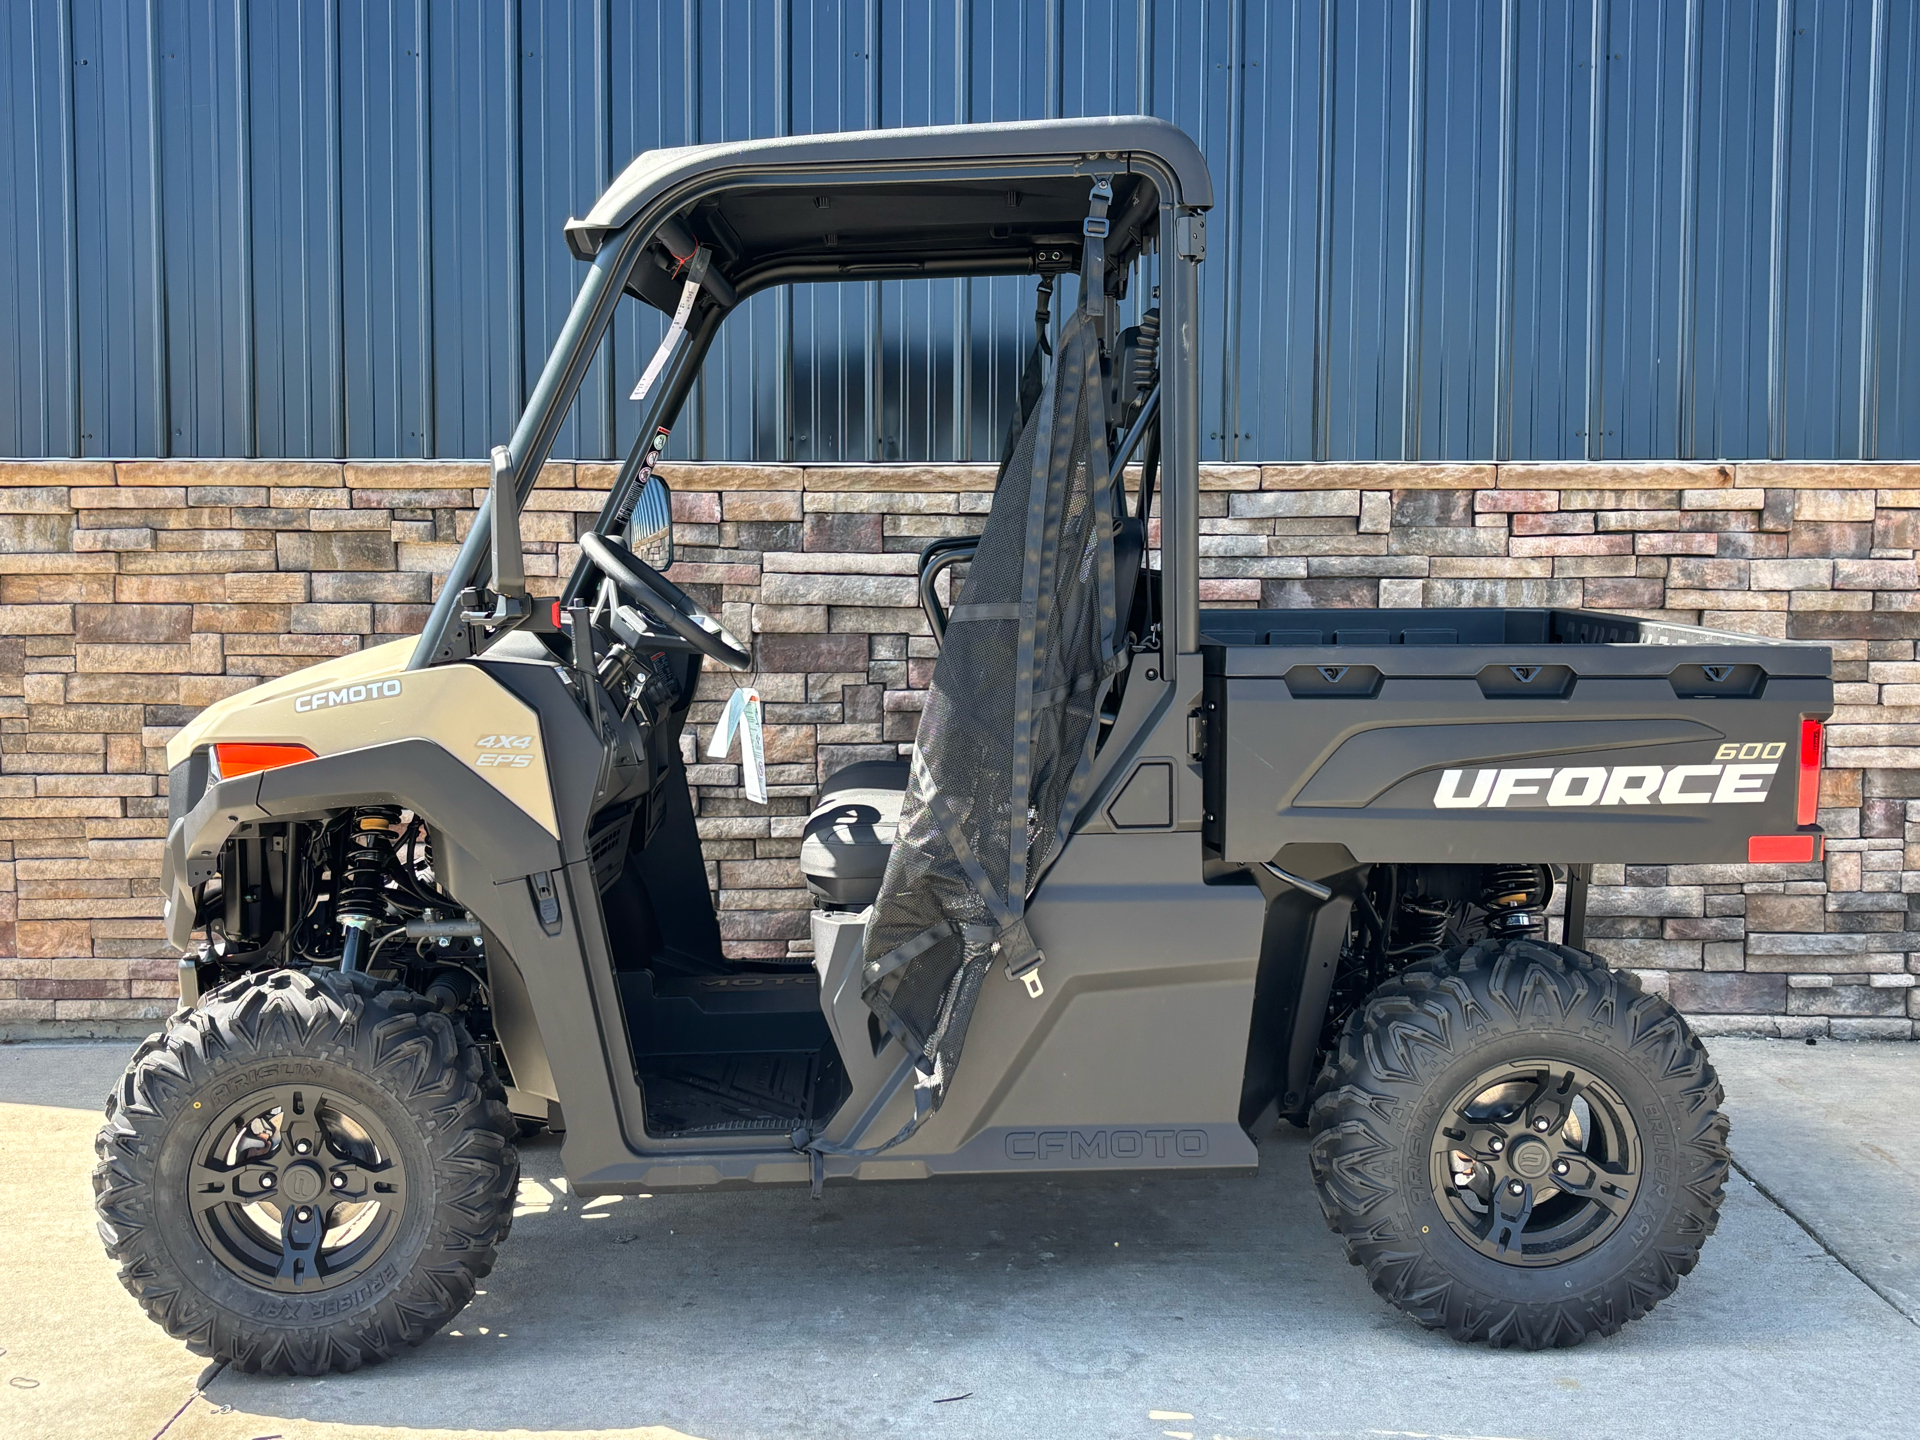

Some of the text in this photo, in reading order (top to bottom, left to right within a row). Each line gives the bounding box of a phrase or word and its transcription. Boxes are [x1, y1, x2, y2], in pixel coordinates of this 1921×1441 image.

[295, 679, 401, 713] CFMOTO
[475, 753, 534, 768] EPS
[476, 735, 533, 749] 4X4
[1714, 742, 1787, 760] 600
[1433, 763, 1779, 808] UFORCE
[209, 1063, 324, 1107] ARISUN
[1005, 1129, 1209, 1160] CFMOTO
[1408, 1094, 1441, 1207] ARISUN
[1642, 1103, 1671, 1198] BRUISER
[310, 1263, 399, 1320] BRUISER
